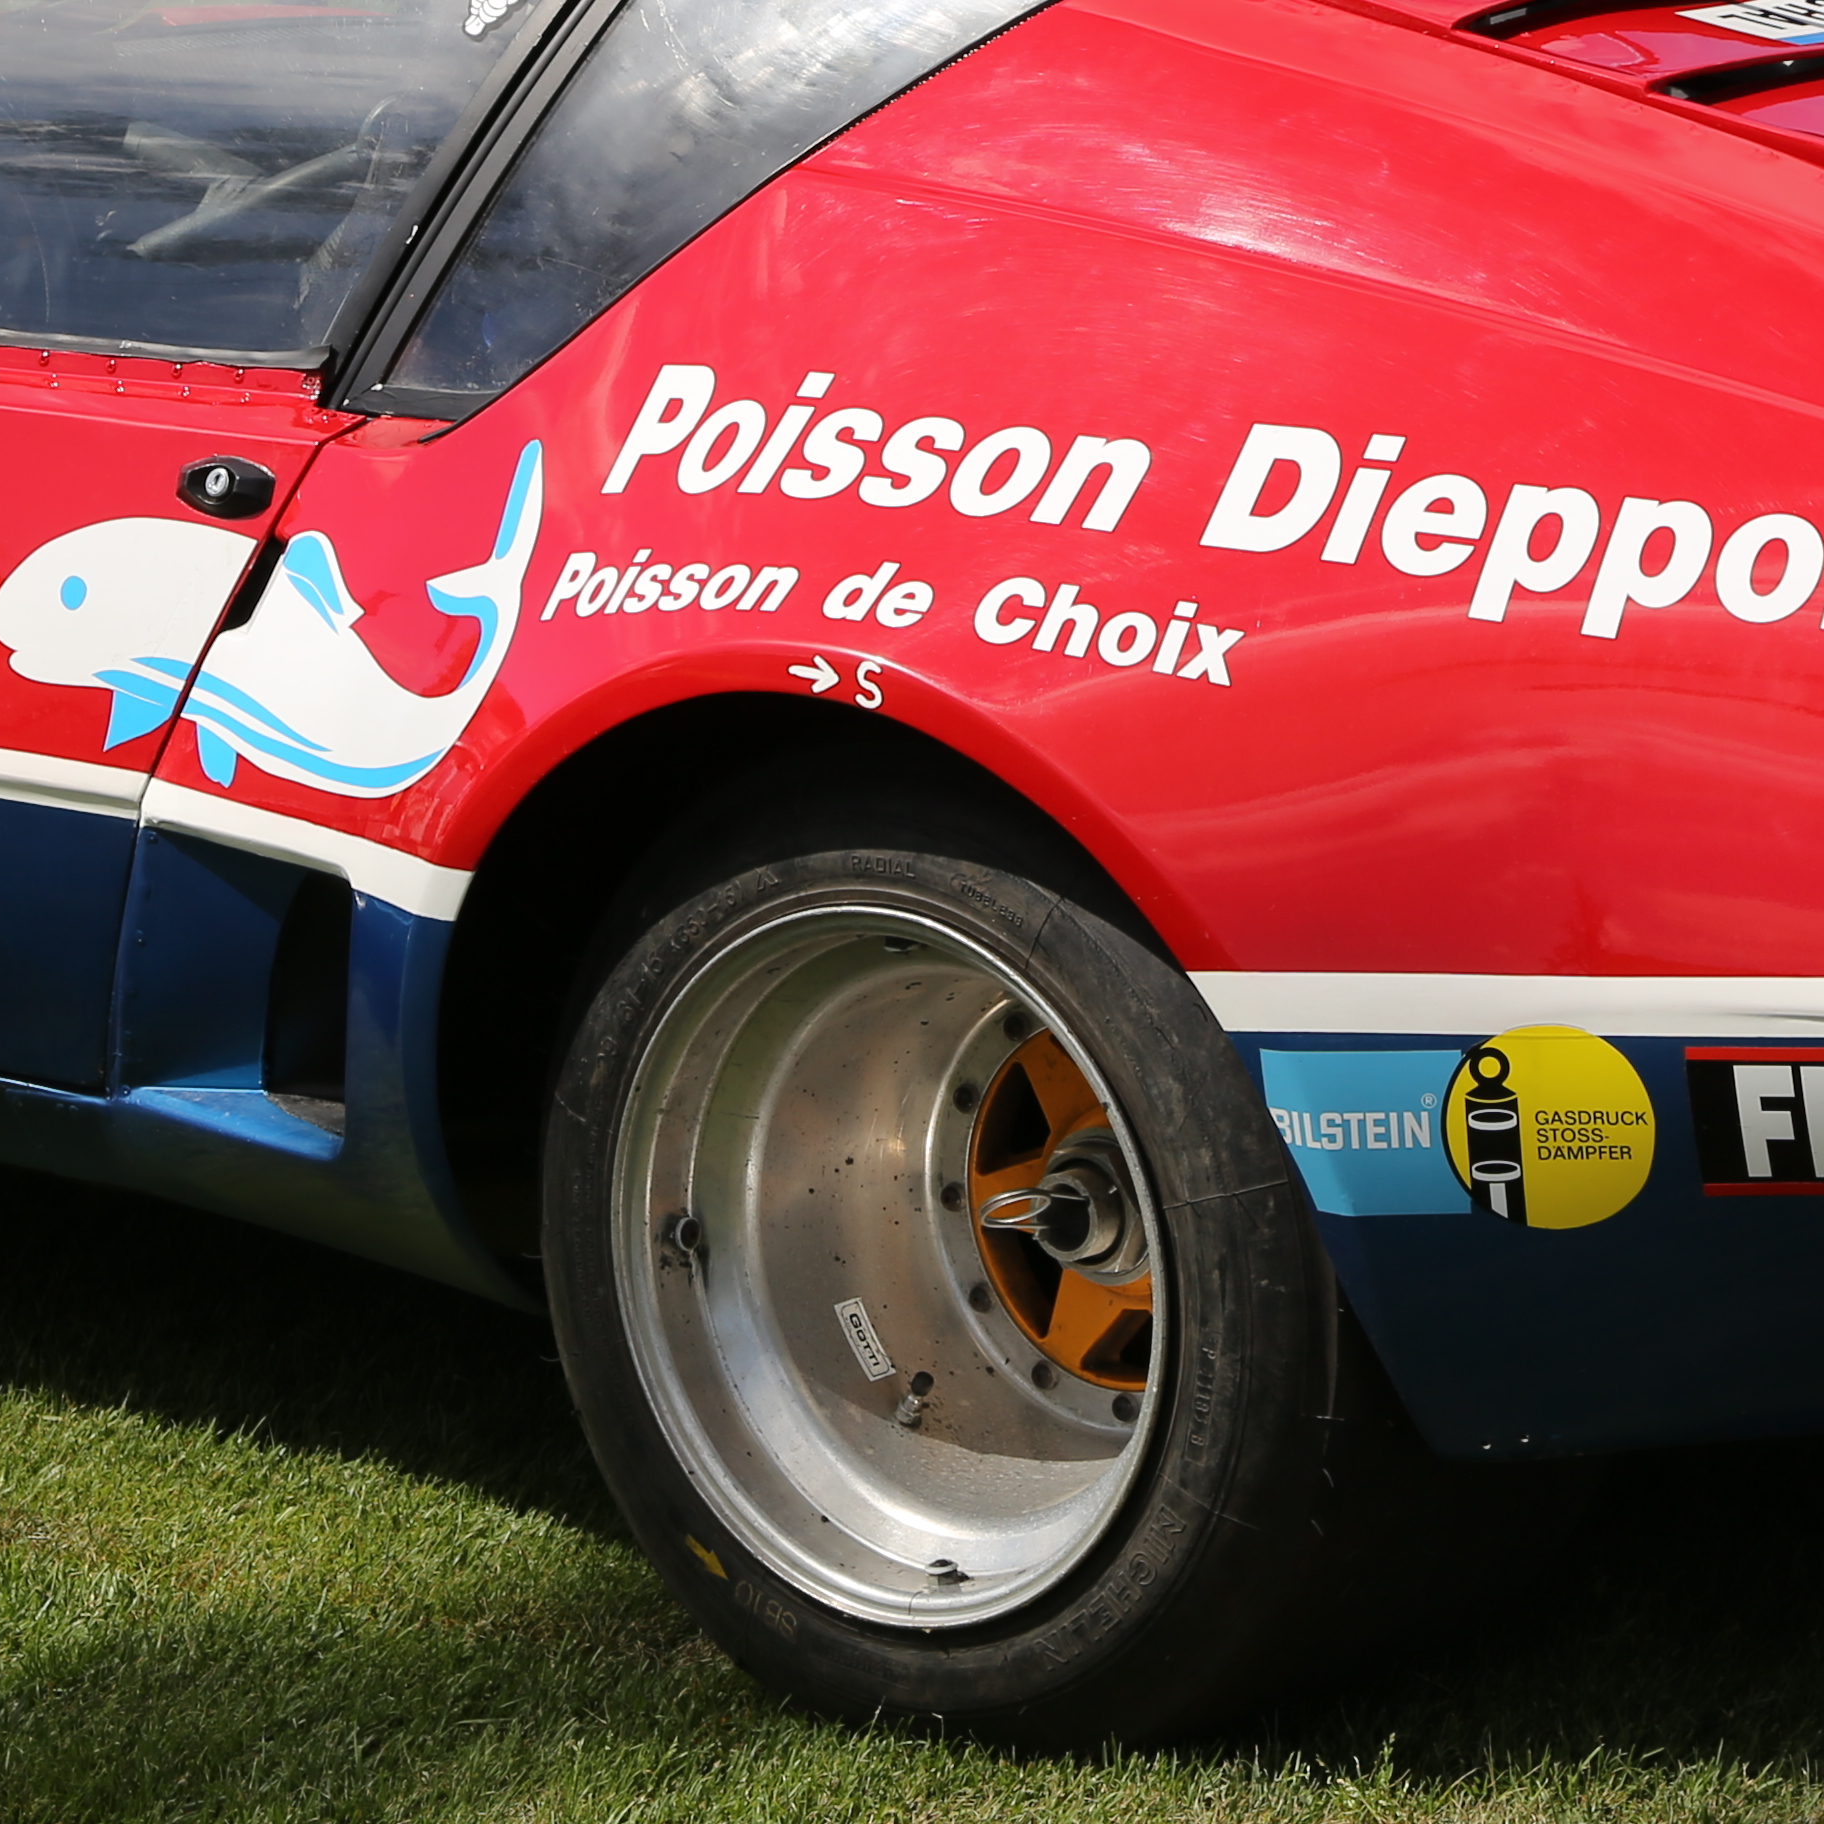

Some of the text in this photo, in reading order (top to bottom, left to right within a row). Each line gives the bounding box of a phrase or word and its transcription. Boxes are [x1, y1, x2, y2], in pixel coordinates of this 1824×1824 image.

[601, 363, 1154, 533] Poisson
[539, 548, 1246, 687] Poisson de Choix
[849, 854, 917, 880] RADIAL
[1269, 1107, 1431, 1151] BILSTEIN
[1533, 1109, 1649, 1127] GASDRUCK
[1535, 1127, 1611, 1144] STOSS-
[1536, 1143, 1633, 1162] DÄMPFER
[847, 1310, 882, 1368] GOTTI
[1042, 1505, 1188, 1674] MICHELIN
